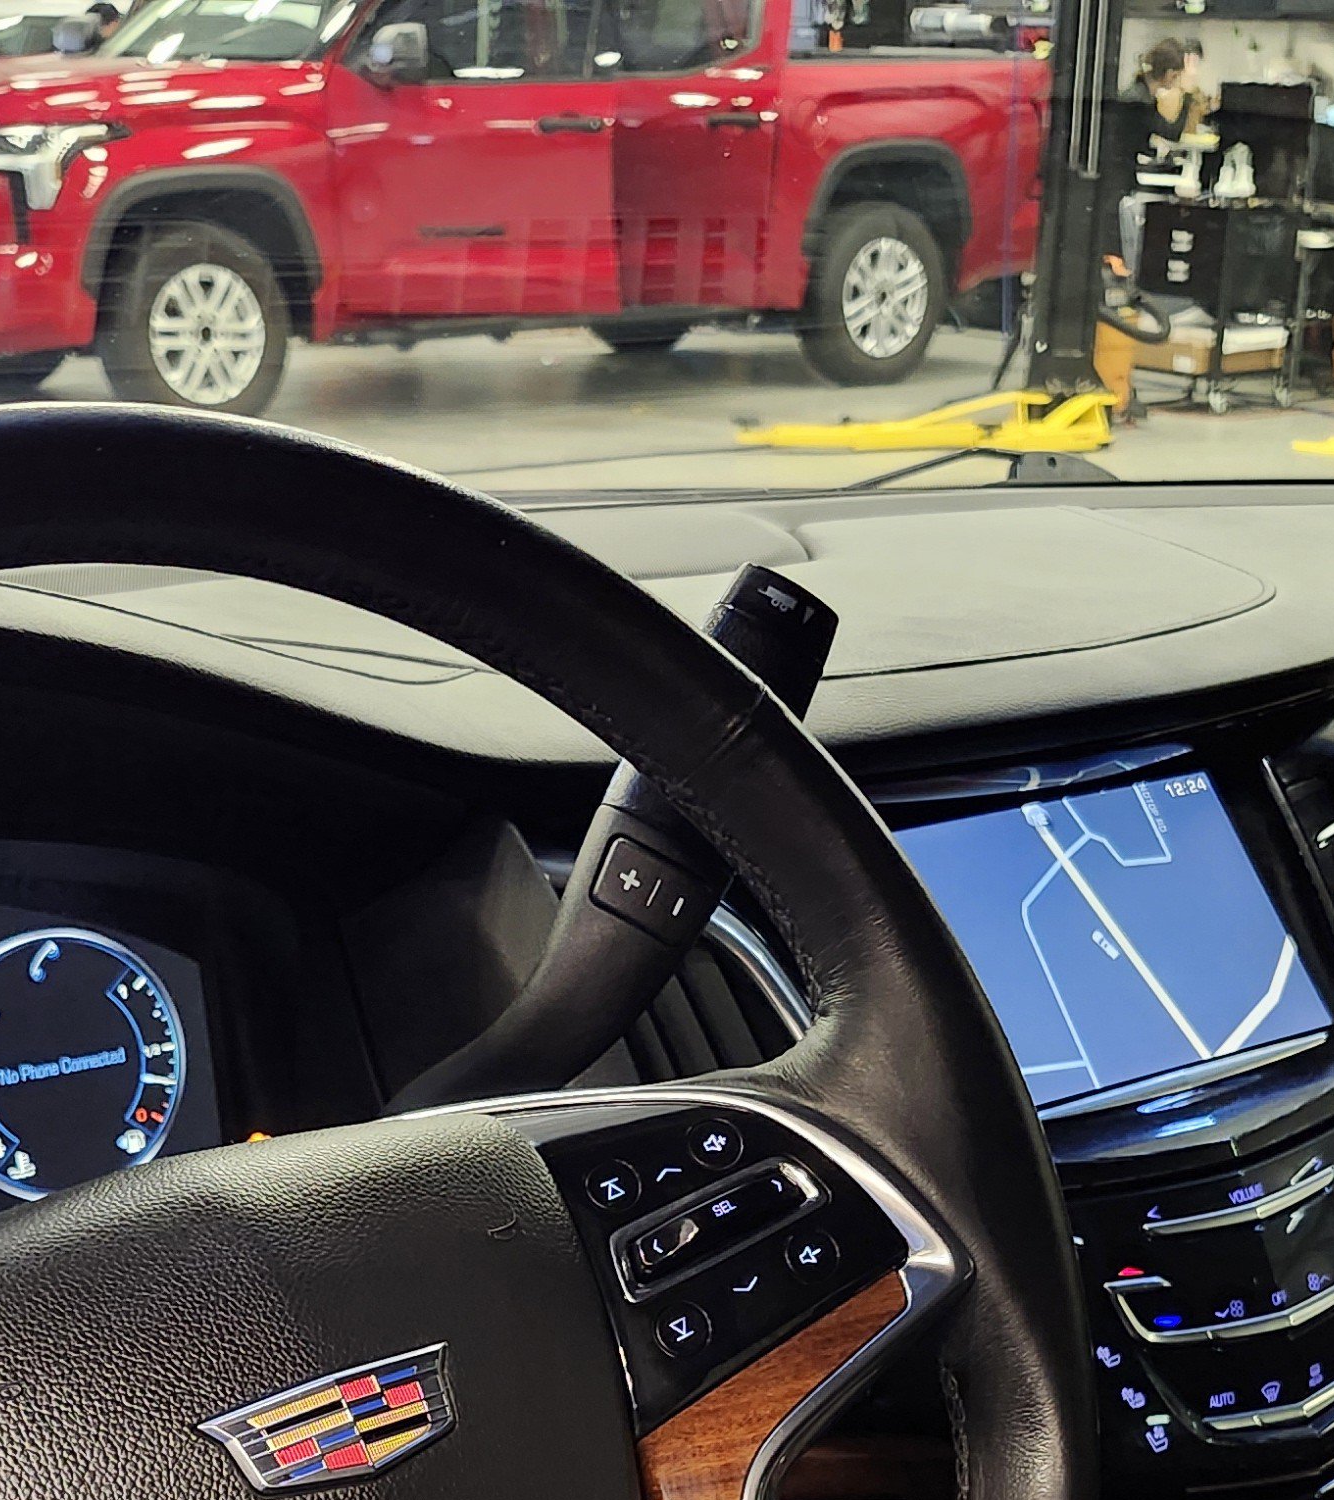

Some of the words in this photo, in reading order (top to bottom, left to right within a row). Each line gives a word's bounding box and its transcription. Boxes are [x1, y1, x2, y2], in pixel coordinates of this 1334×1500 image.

[1164, 777, 1207, 798] 12:24
[19, 1061, 59, 1082] Phone
[58, 1046, 126, 1074] Connected
[1228, 1182, 1265, 1205] VOLUME
[711, 1199, 738, 1218] SEL
[1209, 1391, 1236, 1409] AUTO
